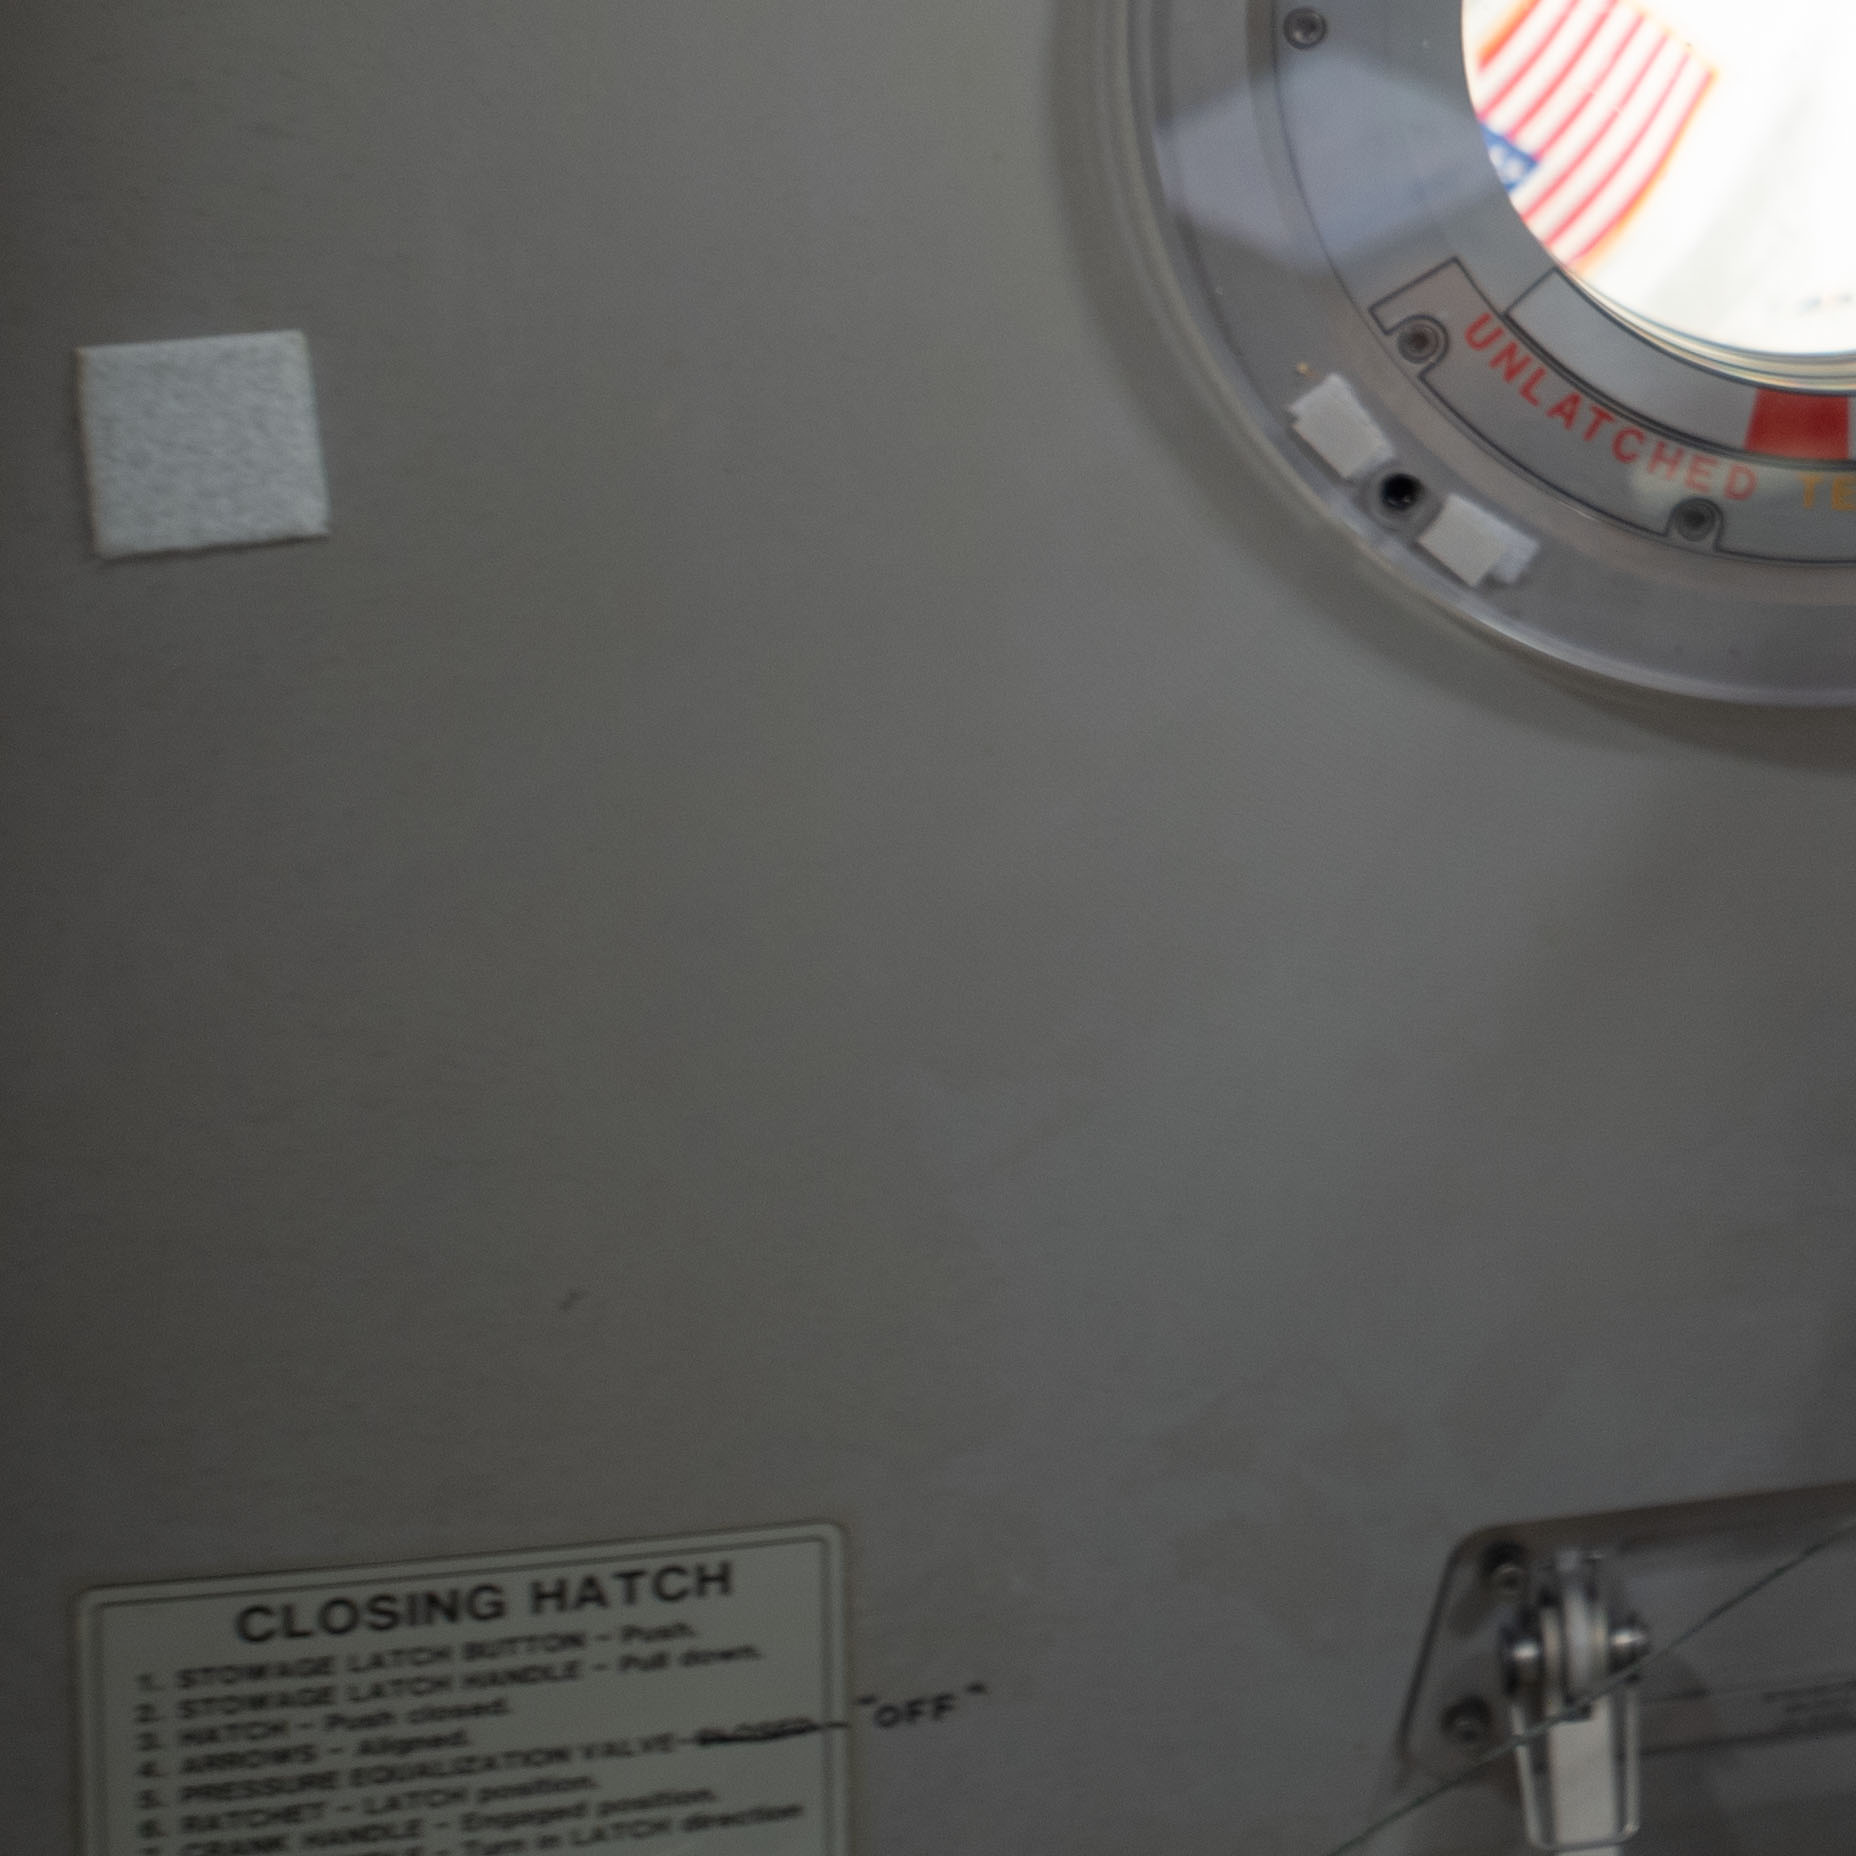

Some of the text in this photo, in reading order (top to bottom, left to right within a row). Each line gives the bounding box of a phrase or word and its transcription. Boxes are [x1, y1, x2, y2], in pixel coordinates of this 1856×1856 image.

[1463, 311, 1757, 501] UNLATCHED
[234, 1560, 733, 1644] CLOSING HATCH
[176, 1655, 336, 1690] STOWAGE
[347, 1644, 453, 1673] LATCH
[460, 1631, 587, 1661] BUTTON
[176, 1685, 336, 1720] STOWAGE
[347, 1675, 453, 1704] LATCH
[460, 1660, 583, 1690] HANDLE
[176, 1719, 291, 1746] HATCH
[360, 1787, 468, 1816] LATCH
